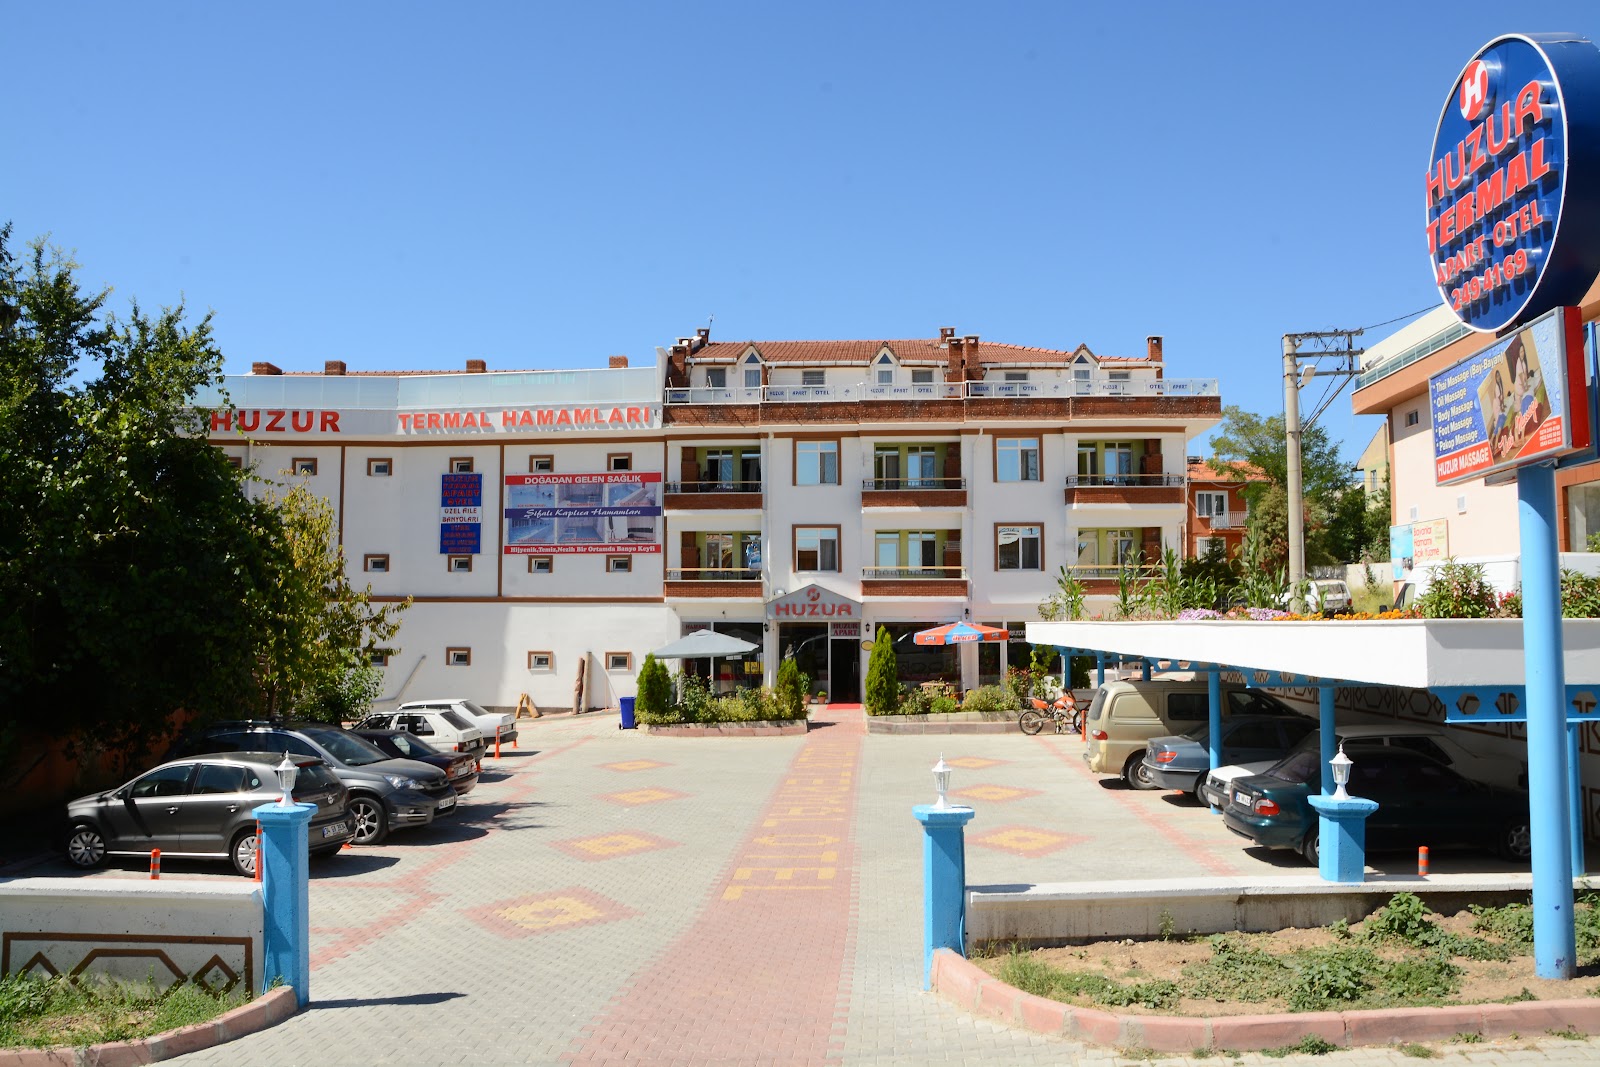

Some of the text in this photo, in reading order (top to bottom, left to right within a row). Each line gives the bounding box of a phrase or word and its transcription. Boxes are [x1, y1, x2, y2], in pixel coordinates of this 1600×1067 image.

[1425, 80, 1543, 210] HUZUR
[1426, 138, 1550, 256] TERMAL
[1437, 199, 1544, 287] APART OTEL
[1447, 369, 1470, 388] Massage
[1445, 387, 1467, 405] Massage
[1450, 400, 1474, 418] Massage
[211, 406, 650, 432] HUZUR TERMAL HAMAMLARI
[1450, 416, 1473, 434] Massage
[1455, 430, 1478, 447] Massage
[1437, 447, 1489, 477] HUZUR MASSAGE
[524, 473, 641, 485] DOĞADAN GELEN SAĞLIK
[443, 489, 480, 497] APART
[775, 603, 852, 616] HUZUR
